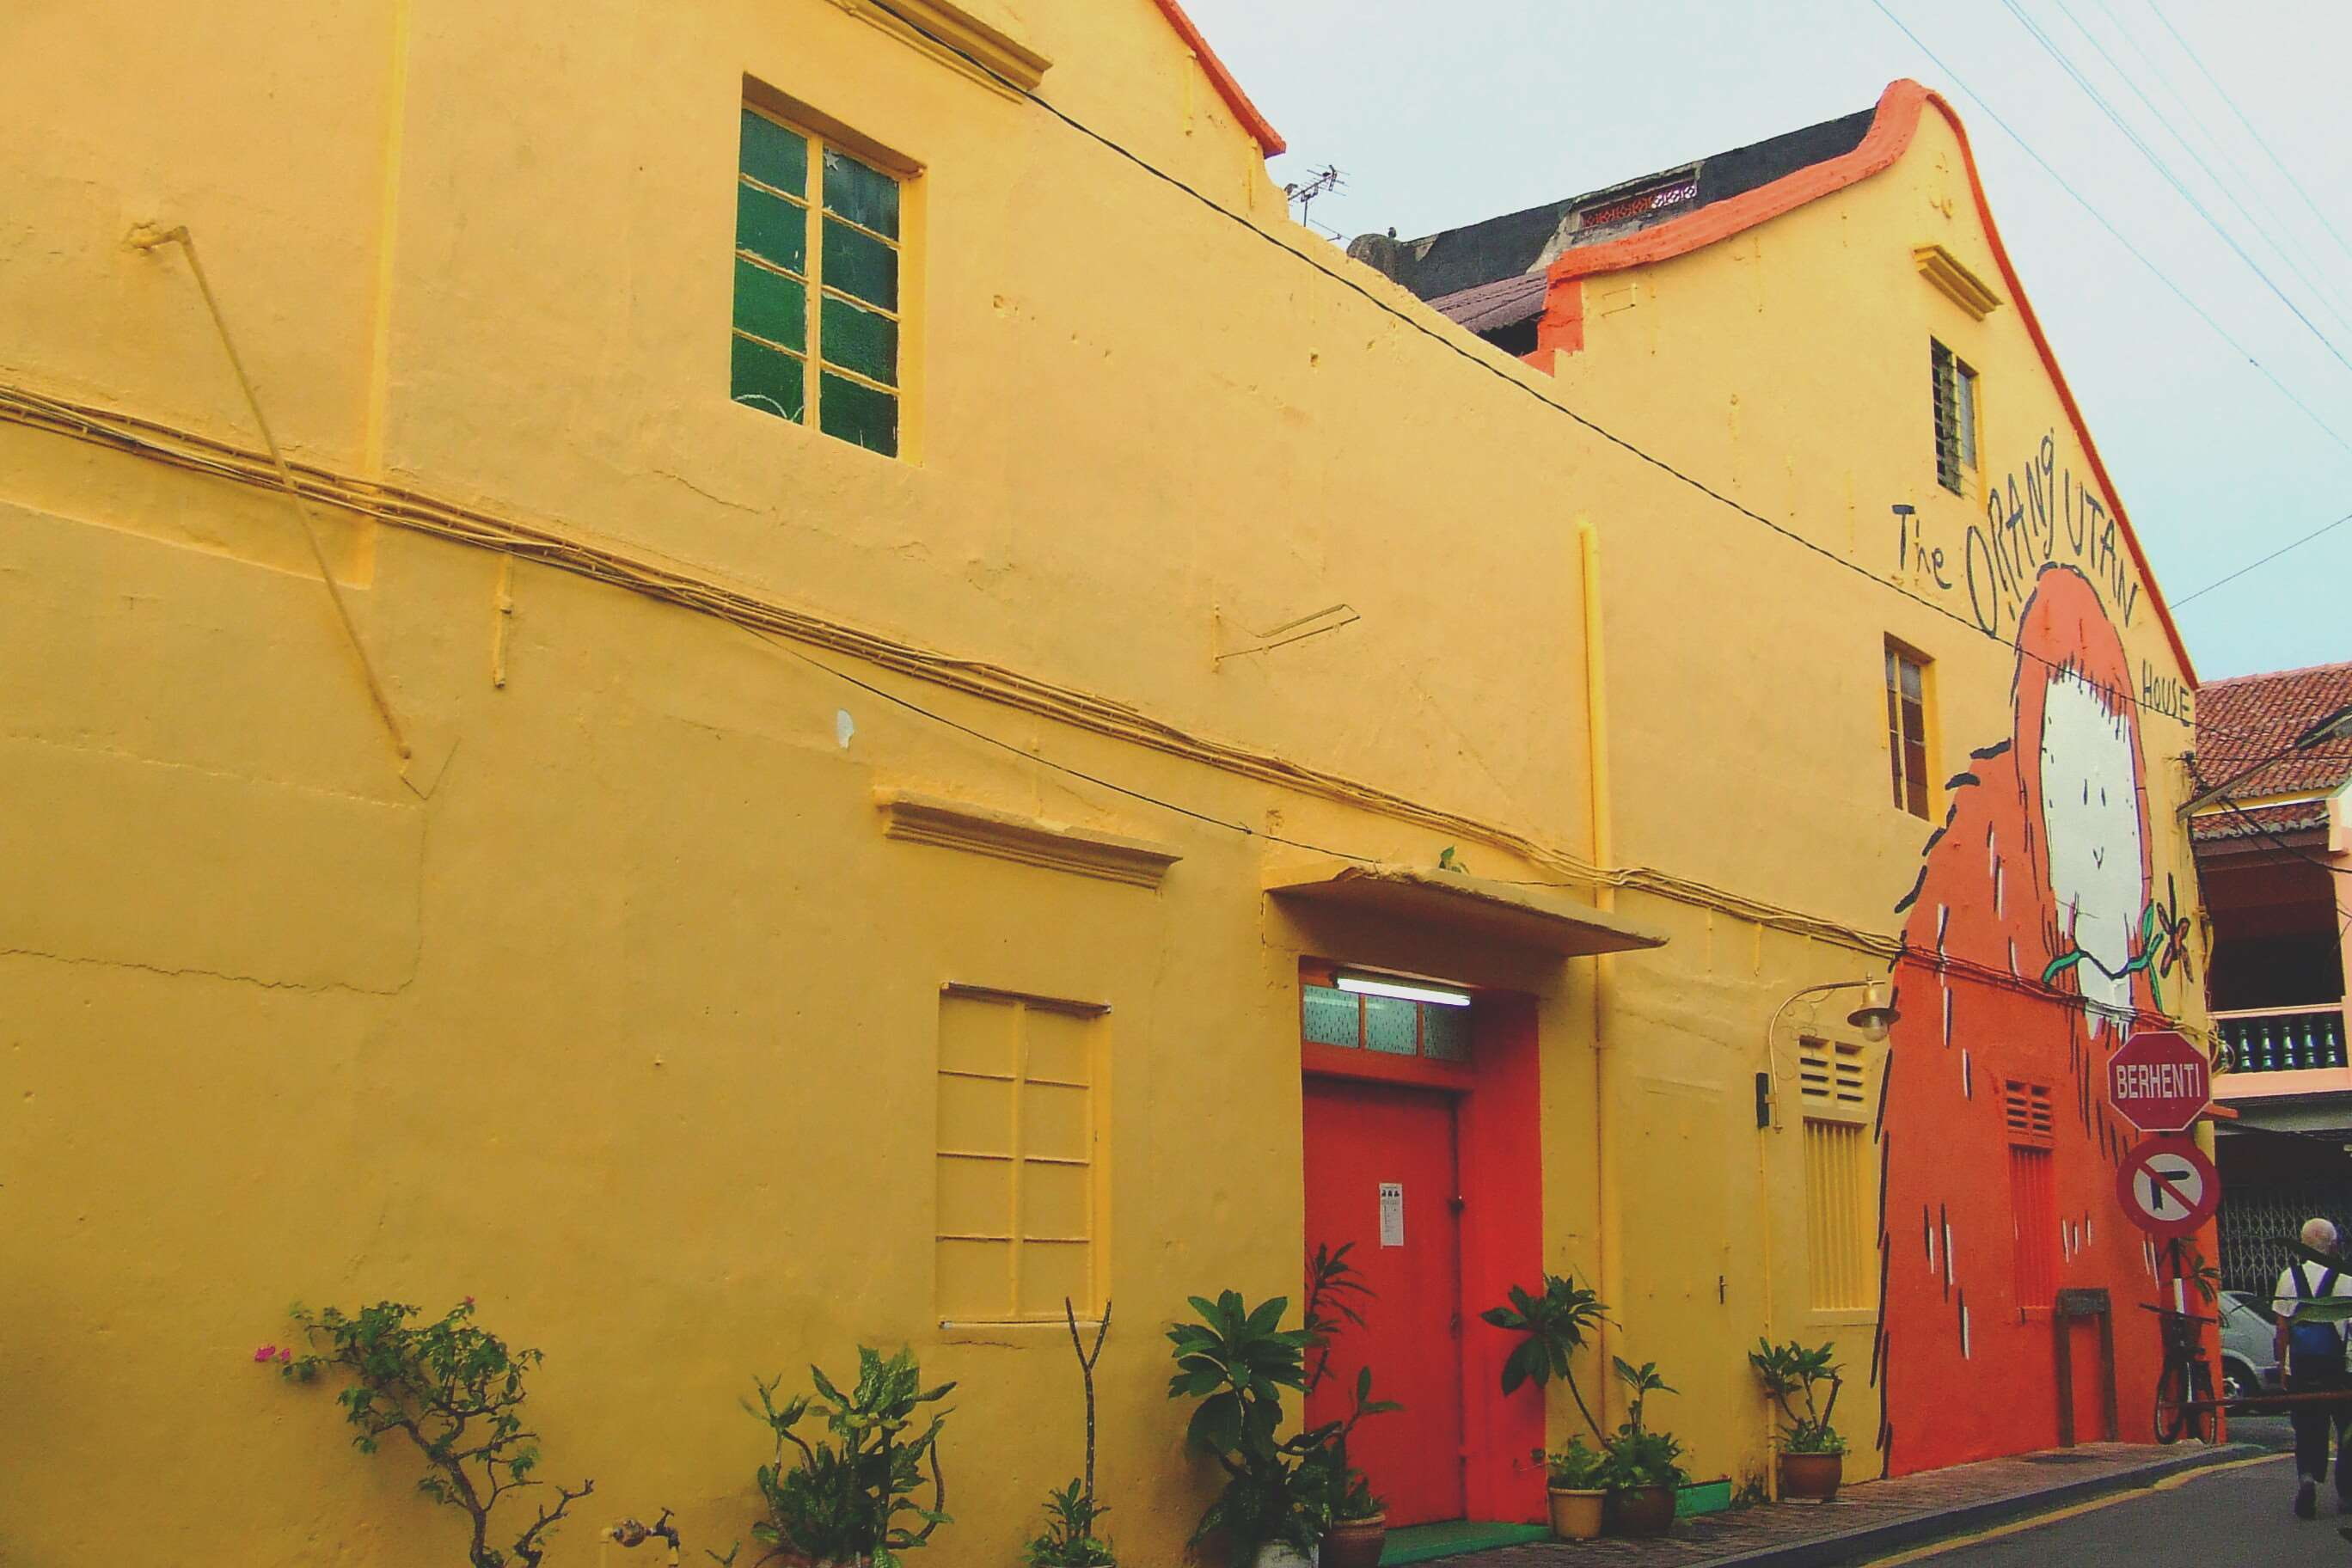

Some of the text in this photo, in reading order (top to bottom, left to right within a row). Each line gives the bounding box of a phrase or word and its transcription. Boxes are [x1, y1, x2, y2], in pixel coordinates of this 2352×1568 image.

[1891, 504, 1952, 590] The
[2065, 469, 2139, 628] UTAN
[2142, 658, 2190, 727] HOUSE
[2116, 1063, 2201, 1099] BERHENTI
